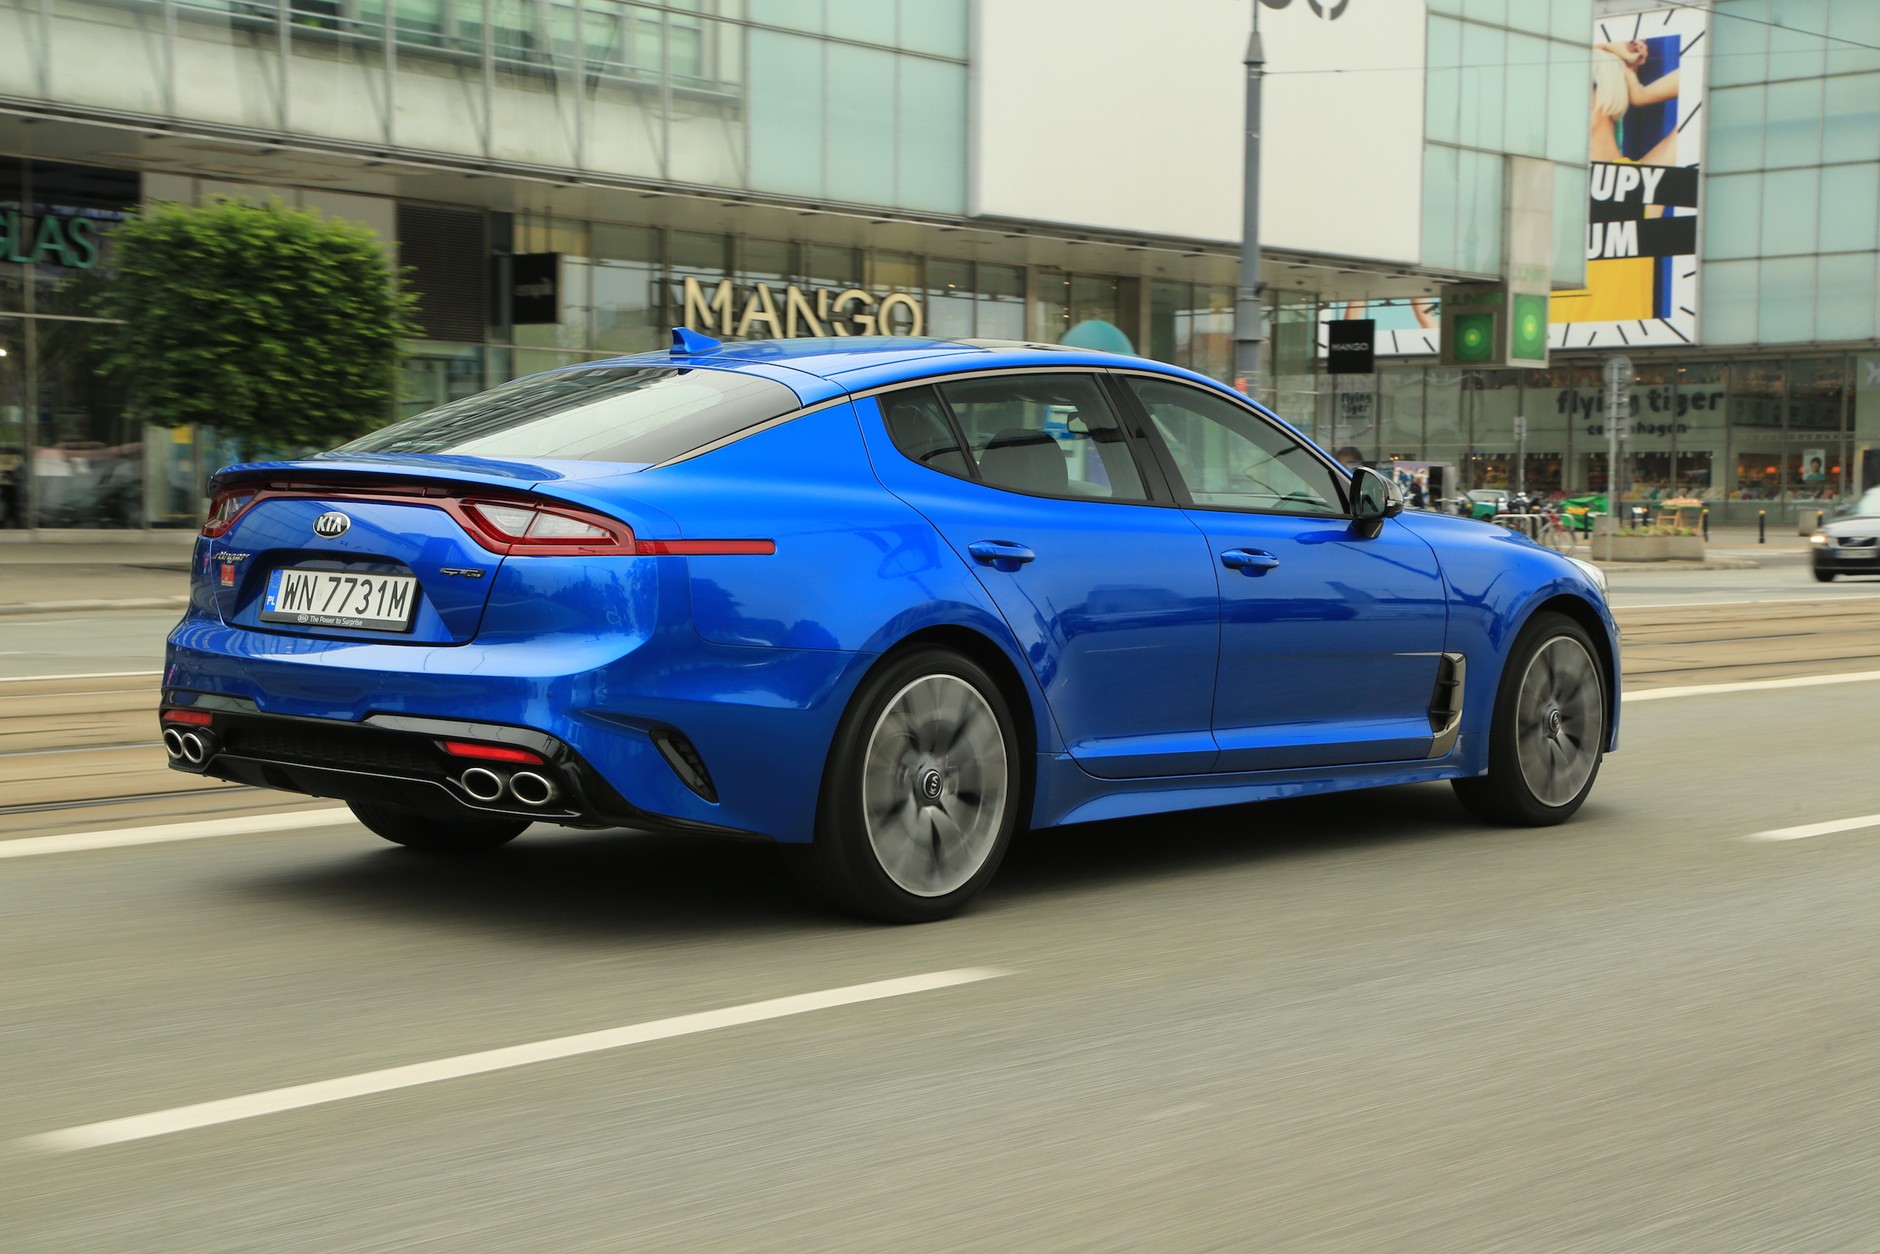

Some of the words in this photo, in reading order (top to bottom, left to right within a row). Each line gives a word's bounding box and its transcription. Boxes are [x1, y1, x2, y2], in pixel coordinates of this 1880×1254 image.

[1588, 163, 1666, 204] UPY
[684, 275, 923, 339] MANGO
[1330, 342, 1370, 352] MANGO
[1556, 388, 1640, 420] flyig
[1646, 386, 1724, 417] tiger
[1587, 421, 1687, 437] cohagen
[315, 515, 344, 533] KIA
[266, 595, 276, 606] PL
[281, 574, 318, 611] WN
[321, 576, 410, 618] 7731M
[310, 615, 320, 623] The
[320, 616, 335, 624] Power
[342, 617, 363, 627] Surprise
